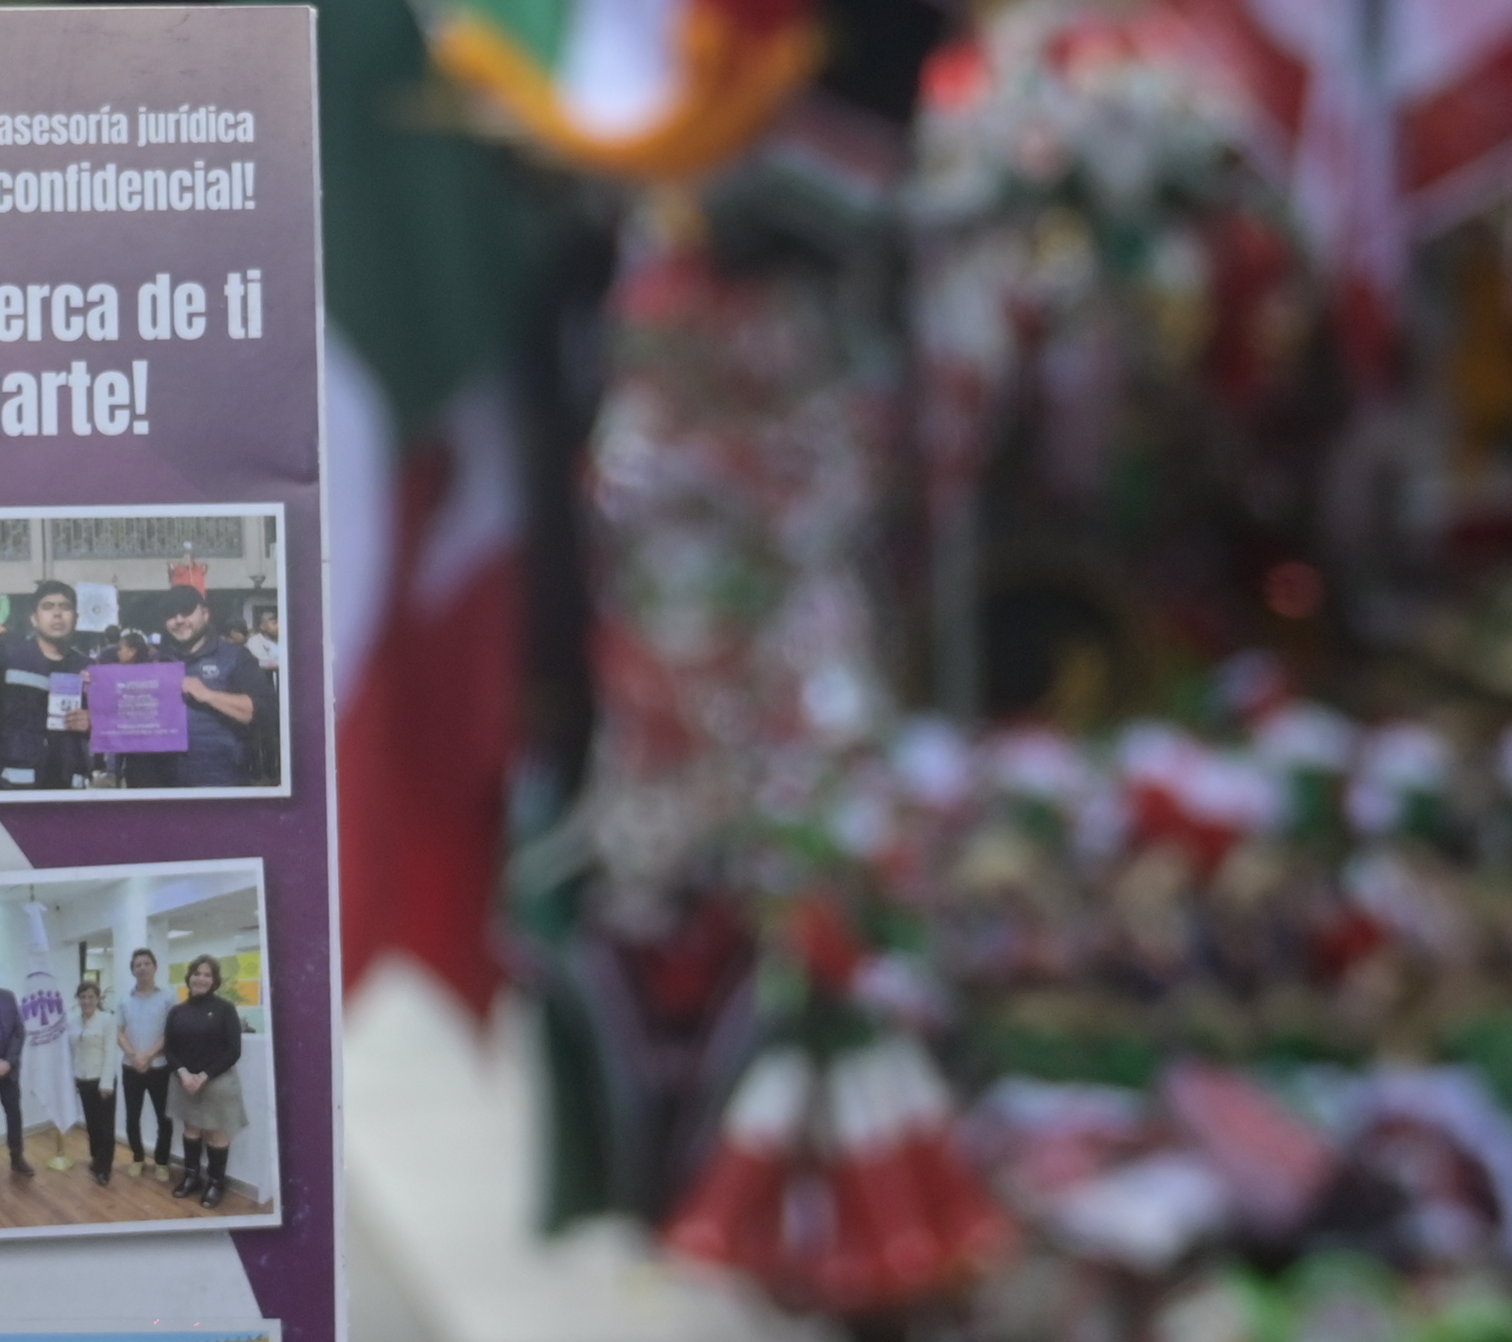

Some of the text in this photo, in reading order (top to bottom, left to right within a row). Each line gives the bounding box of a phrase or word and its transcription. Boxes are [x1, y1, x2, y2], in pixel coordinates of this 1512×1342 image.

[137, 103, 255, 147] jurídica
[137, 272, 207, 341] de
[223, 268, 263, 340] ti
